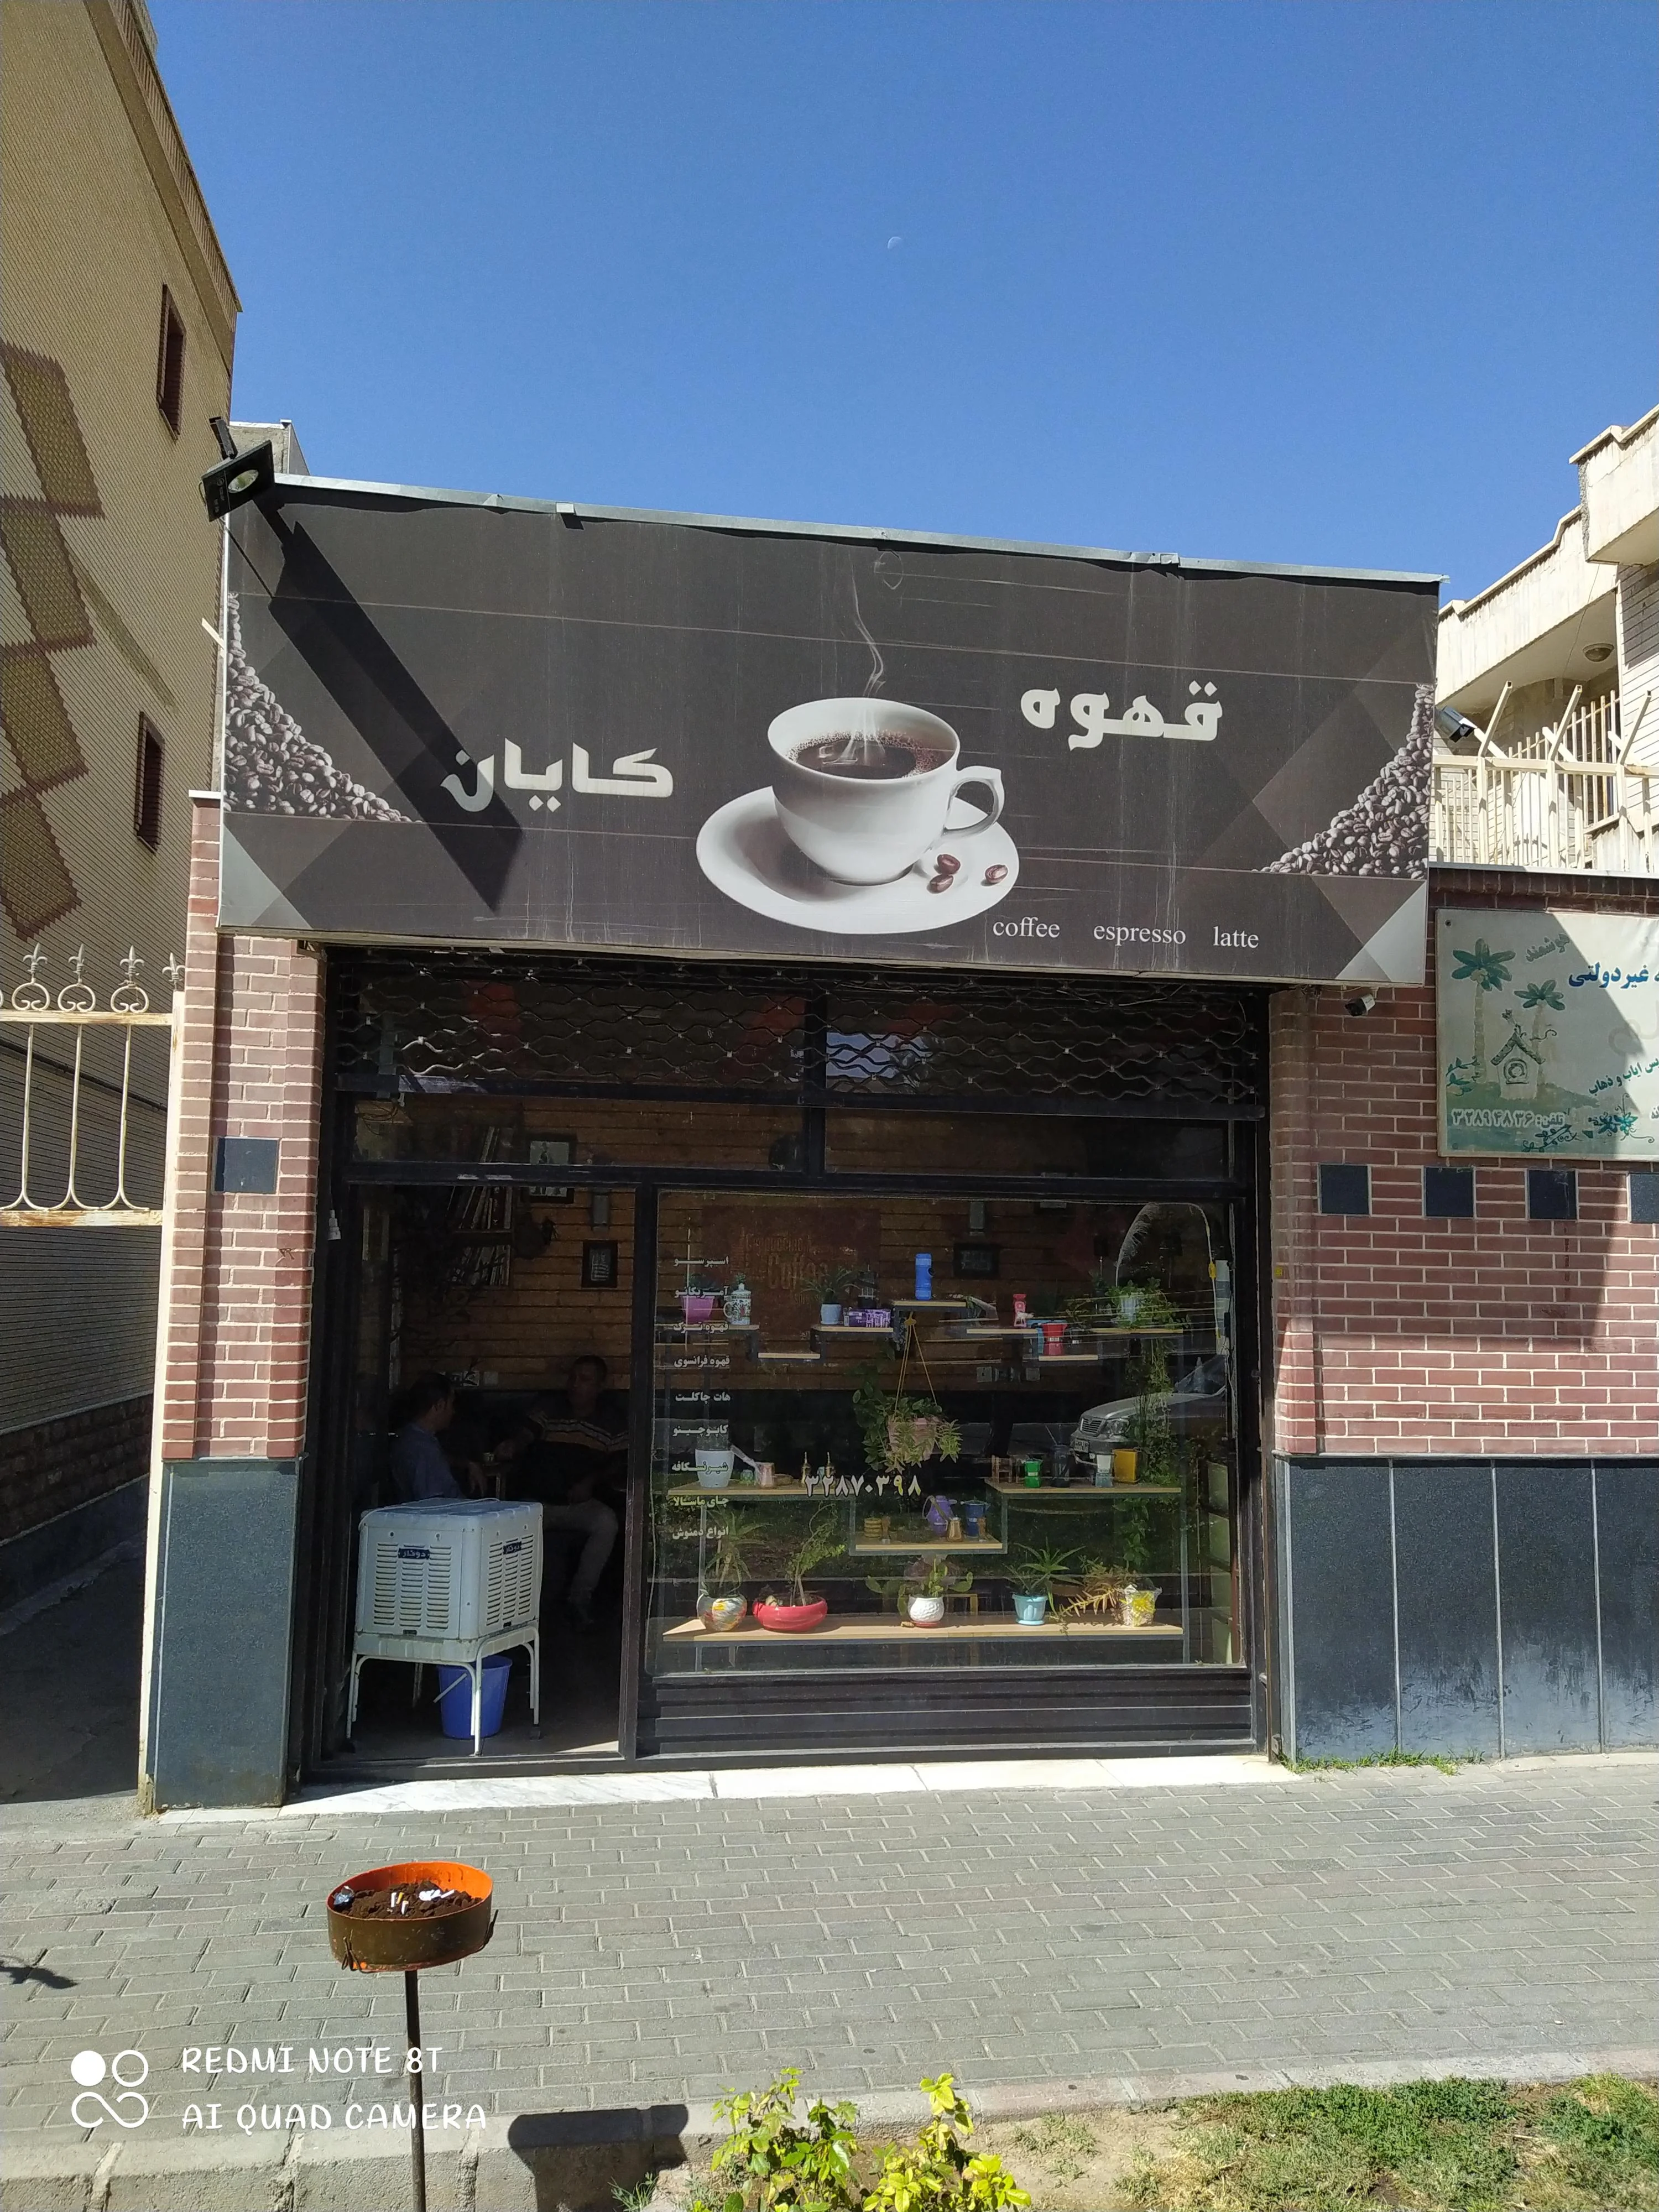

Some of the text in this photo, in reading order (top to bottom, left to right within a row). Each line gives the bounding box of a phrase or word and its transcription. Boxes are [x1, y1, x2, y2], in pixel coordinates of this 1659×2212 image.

[1020, 680, 1223, 752] قهوه
[440, 737, 674, 812] کایان
[993, 916, 1259, 948] coffee espresso latte
[1525, 933, 1571, 963] هوشمند
[1623, 1062, 1642, 1082] ایاب
[1588, 1074, 1614, 1096] ذهاب
[1616, 1075, 1623, 1088] و
[673, 1256, 729, 1268] اسپرسو
[674, 1286, 729, 1298] آمریکانو
[672, 1322, 729, 1335] قهوه ترک
[674, 1354, 730, 1368] قهوه فرانسوی
[675, 1391, 731, 1405] هات چاکلت
[672, 1425, 729, 1437] کاپوچینو
[805, 1474, 922, 1498] ۳۲۸۷۰۳۹۸
[672, 1495, 729, 1508] چای ماسالا
[672, 1526, 729, 1540] انواع دمنوش
